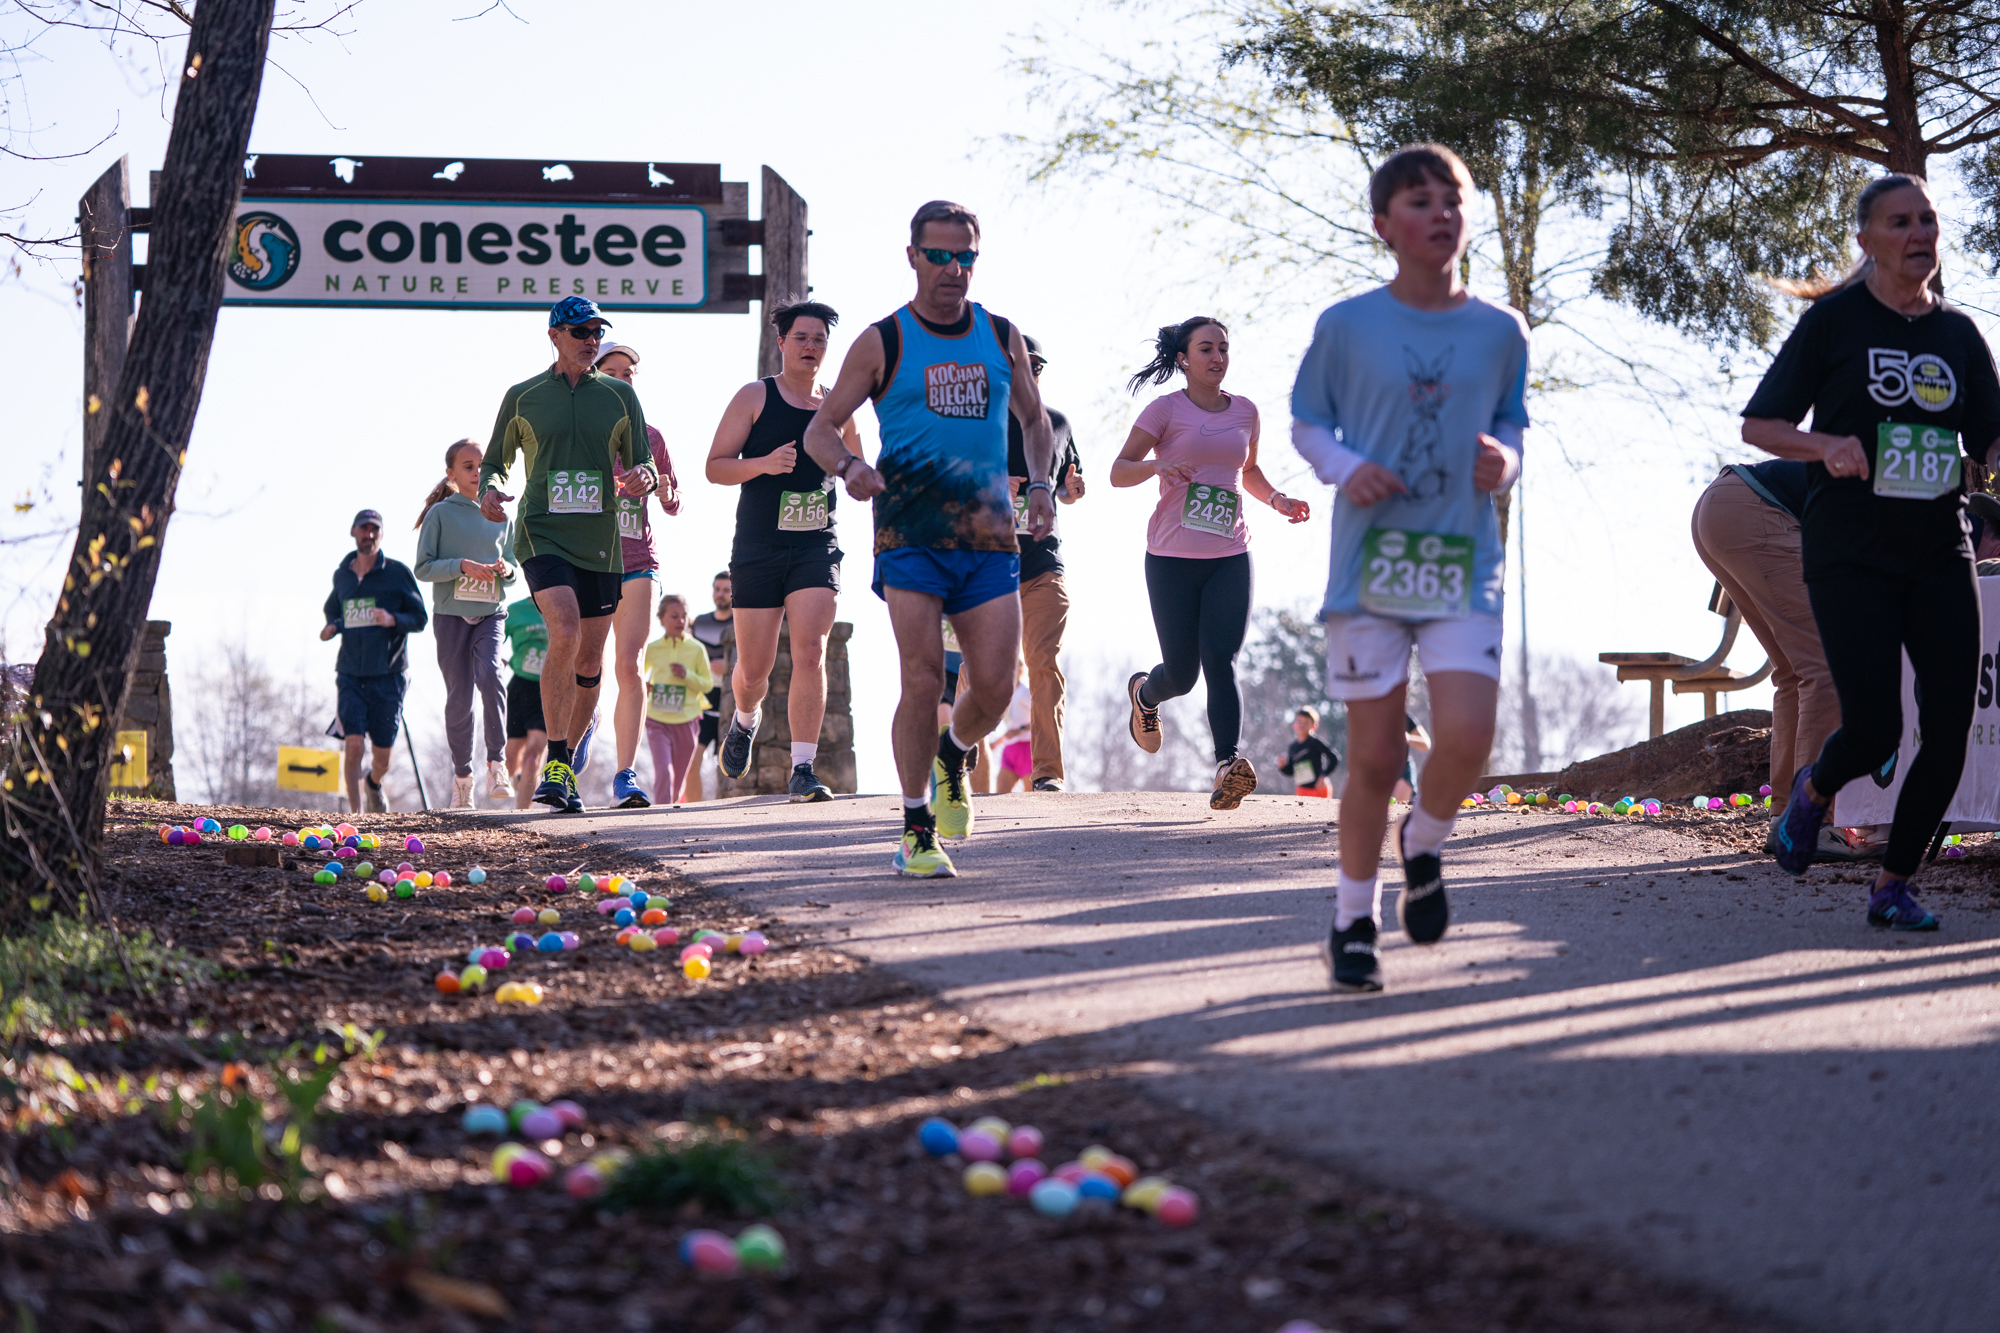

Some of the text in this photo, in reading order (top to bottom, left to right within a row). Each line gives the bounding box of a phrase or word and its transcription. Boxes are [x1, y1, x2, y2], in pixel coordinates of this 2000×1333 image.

[323, 214, 686, 267] conestee
[325, 275, 684, 296] NATURE PRESERVE
[944, 405, 985, 418] POLSCE
[1882, 448, 1956, 484] 2187
[551, 484, 599, 504] 2142
[617, 511, 637, 530] 01
[782, 503, 825, 522] 2156
[1187, 499, 1233, 527] 2425
[458, 576, 496, 595] 2241
[1368, 557, 1464, 602] 2363
[345, 607, 374, 621] 2240
[653, 692, 684, 706] 2147
